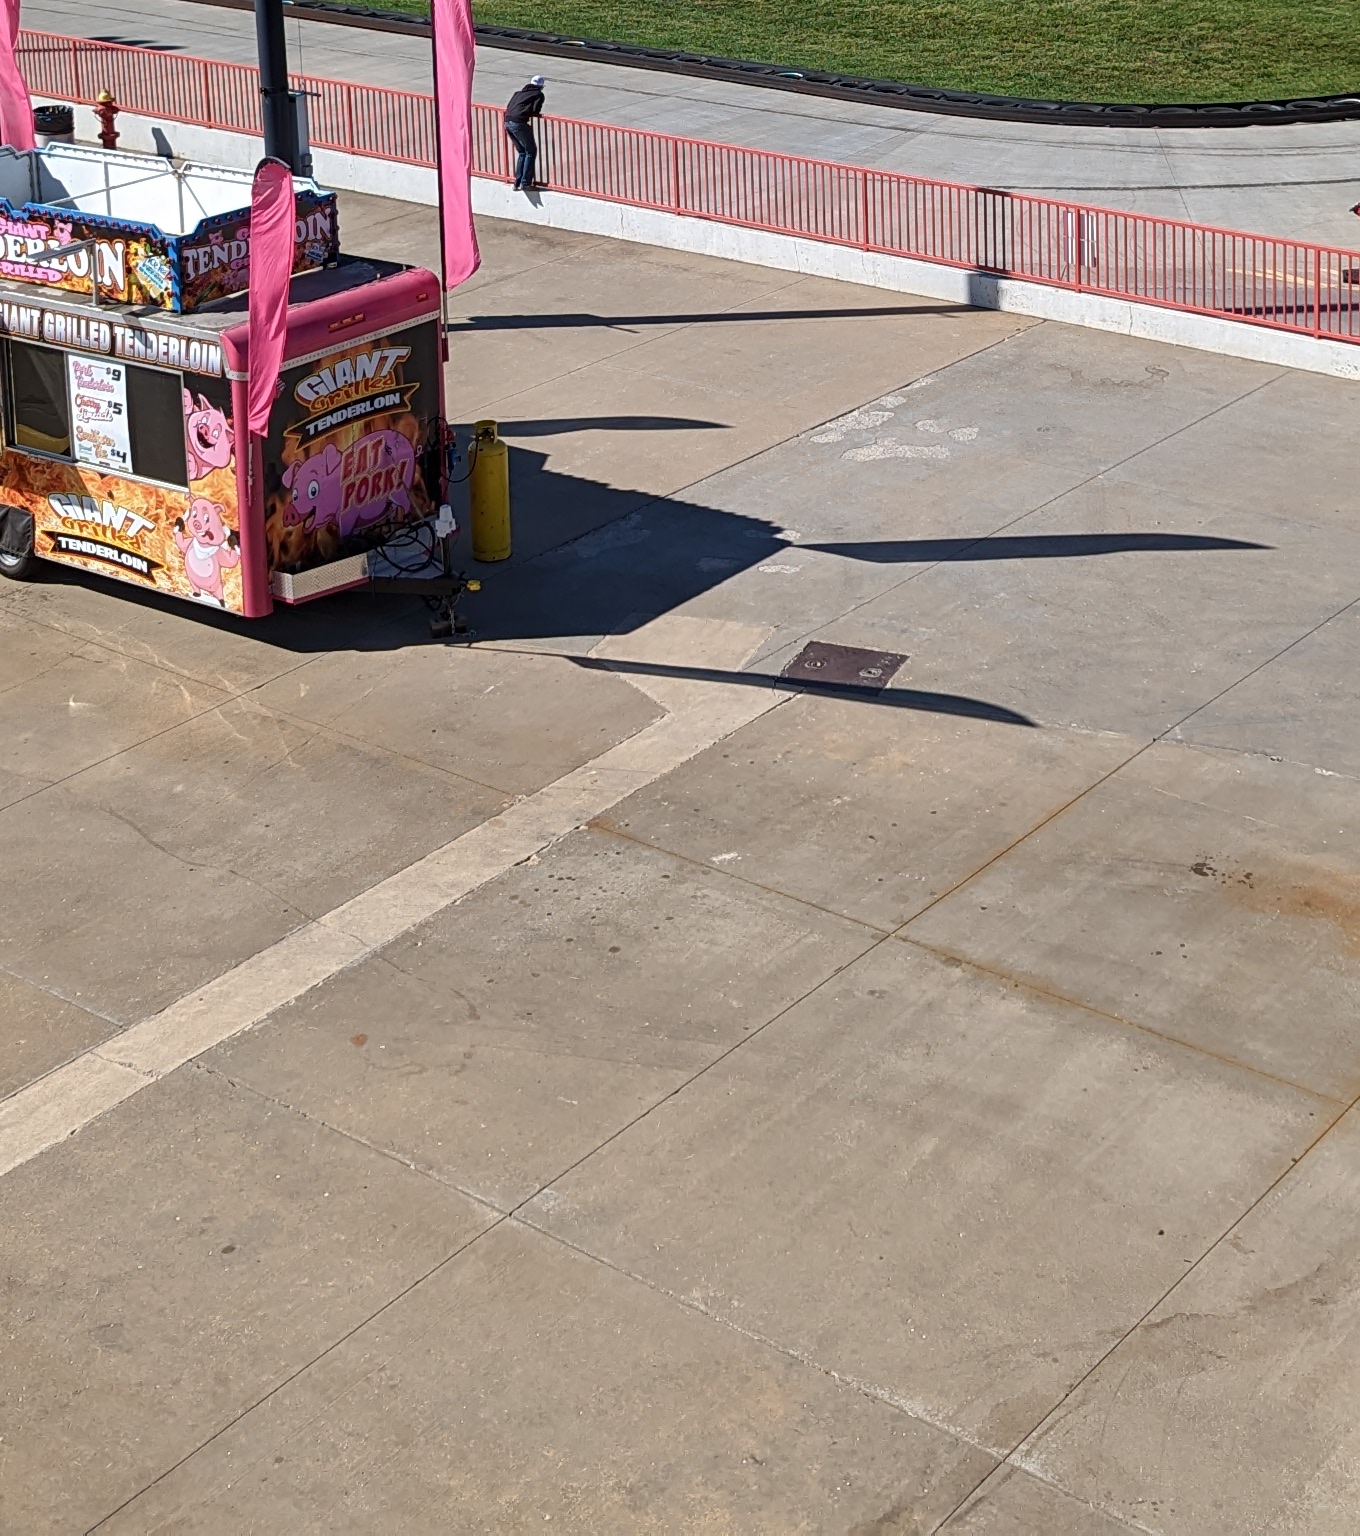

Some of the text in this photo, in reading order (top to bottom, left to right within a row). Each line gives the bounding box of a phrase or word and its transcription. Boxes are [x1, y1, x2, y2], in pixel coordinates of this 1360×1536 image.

[183, 207, 332, 281] TENDOIN
[44, 310, 110, 352] GRILLED
[113, 323, 222, 375] TENDERLOIN
[106, 367, 121, 381] $9
[296, 346, 411, 402] GIANT
[311, 370, 396, 411] Grilled
[107, 401, 123, 415] $5
[306, 392, 401, 436] TENDERLOIN
[111, 449, 127, 463] $4
[342, 437, 384, 482] EAT
[342, 458, 410, 514] PORK!
[48, 493, 156, 537] GIANT
[61, 516, 140, 549] Grilled
[57, 537, 148, 573] TENDERLOIN
